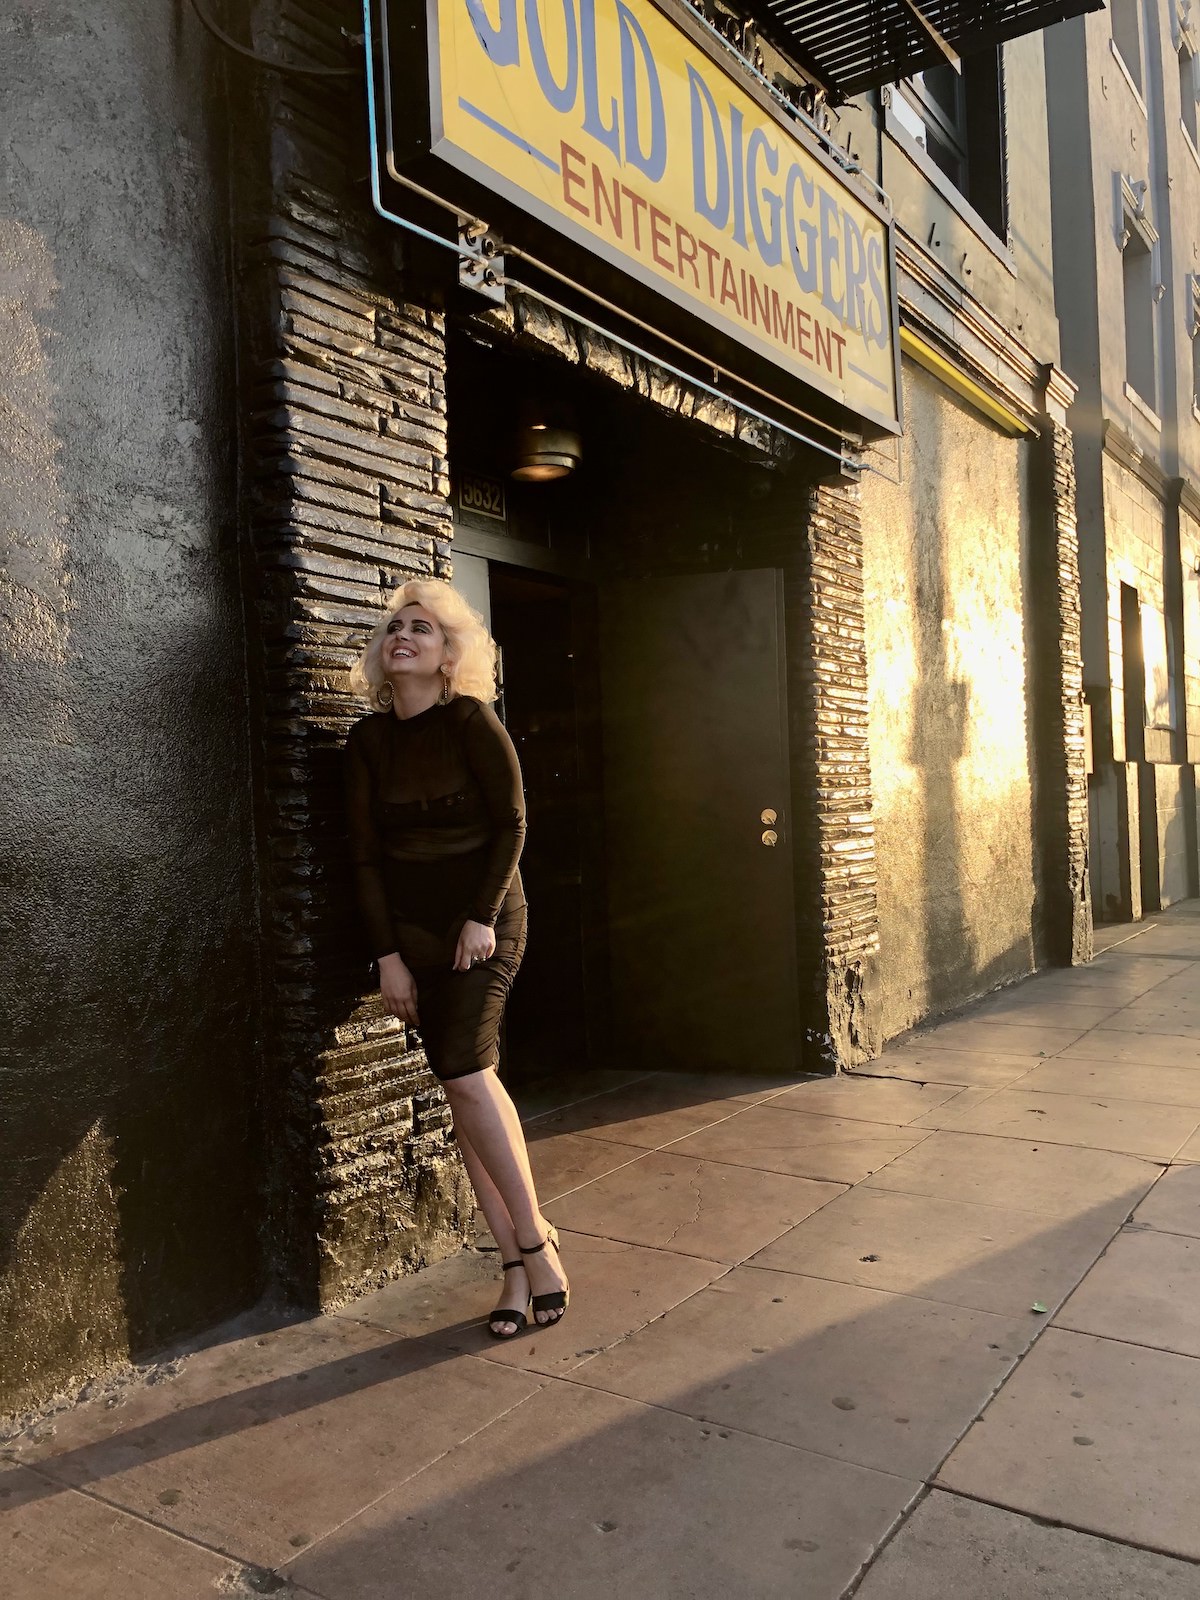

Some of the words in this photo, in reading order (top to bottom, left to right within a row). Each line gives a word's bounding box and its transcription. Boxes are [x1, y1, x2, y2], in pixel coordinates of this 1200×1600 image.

[560, 139, 847, 380] ENTERTAINMENT
[684, 59, 888, 356] DIGGERS
[464, 479, 501, 513] 5632
